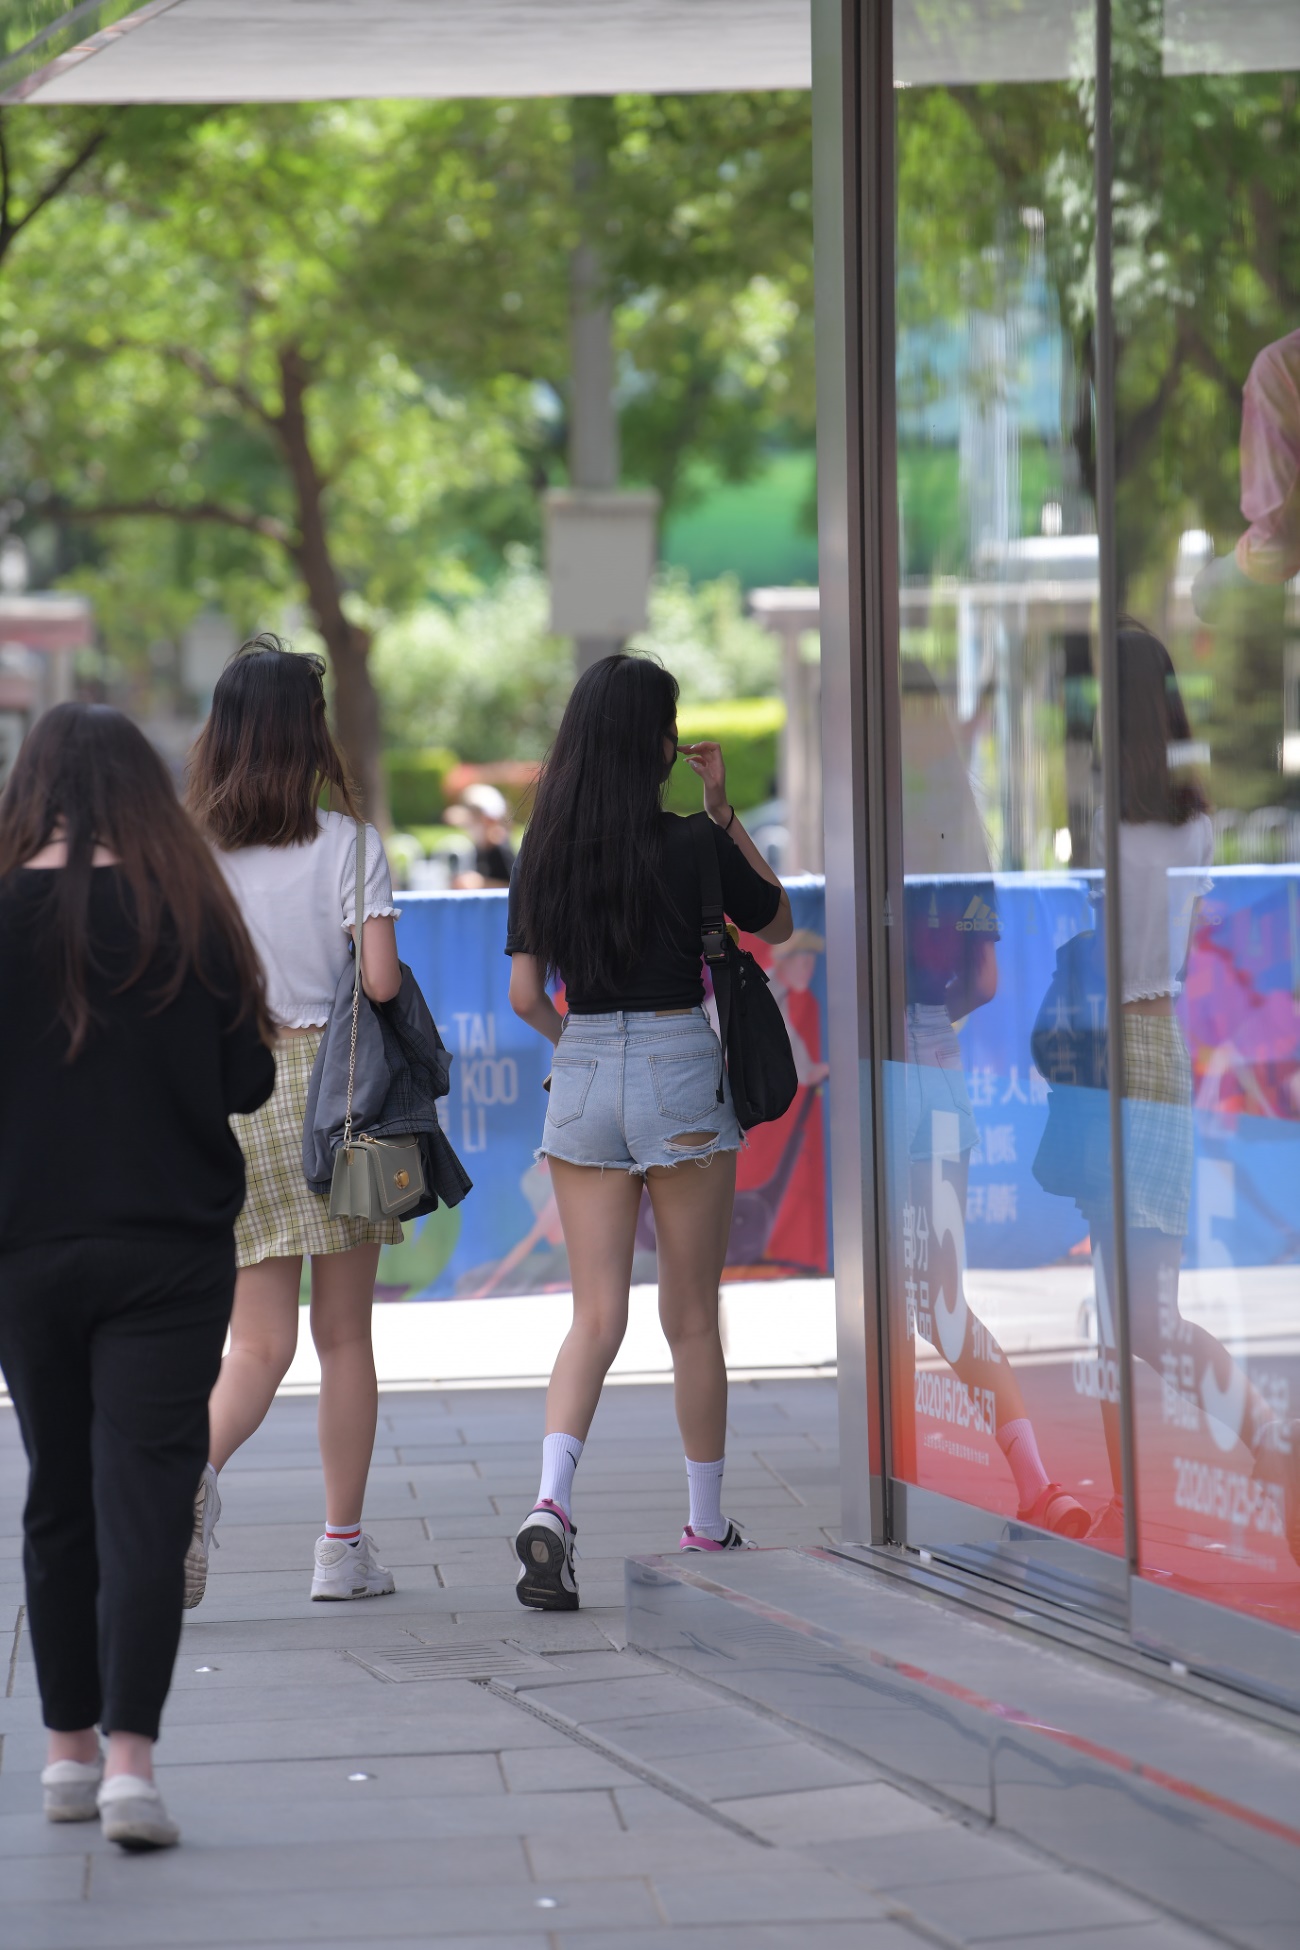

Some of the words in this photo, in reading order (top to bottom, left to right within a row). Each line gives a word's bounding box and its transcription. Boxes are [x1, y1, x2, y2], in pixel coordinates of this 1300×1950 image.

[452, 1012, 497, 1057] TAI
[461, 1056, 519, 1105] KOO
[462, 1106, 487, 1153] LI
[902, 1200, 929, 1272] 部分
[904, 1276, 932, 1346] 商品
[914, 1370, 996, 1438] 2020/5/23-5/31
